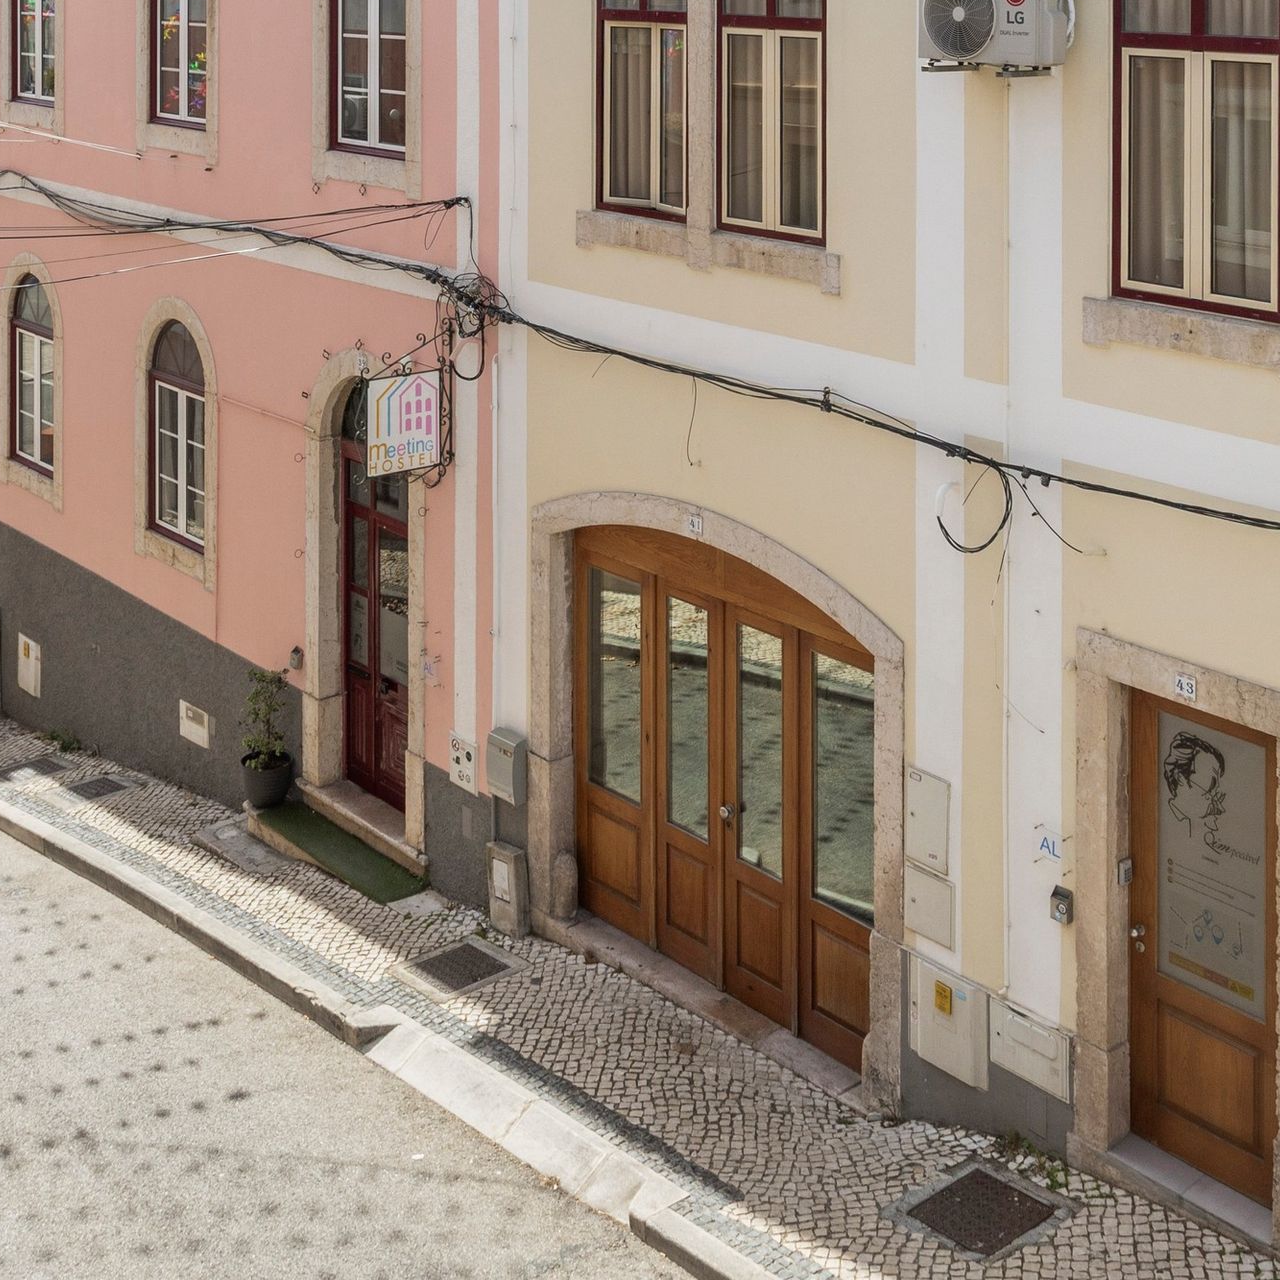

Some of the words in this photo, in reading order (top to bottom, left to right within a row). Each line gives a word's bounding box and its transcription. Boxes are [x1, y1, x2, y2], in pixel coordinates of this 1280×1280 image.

[1006, 10, 1025, 25] LG
[369, 454, 435, 475] HOSTEL
[689, 519, 701, 531] 41
[1176, 678, 1194, 695] 43
[1040, 836, 1061, 859] AL
